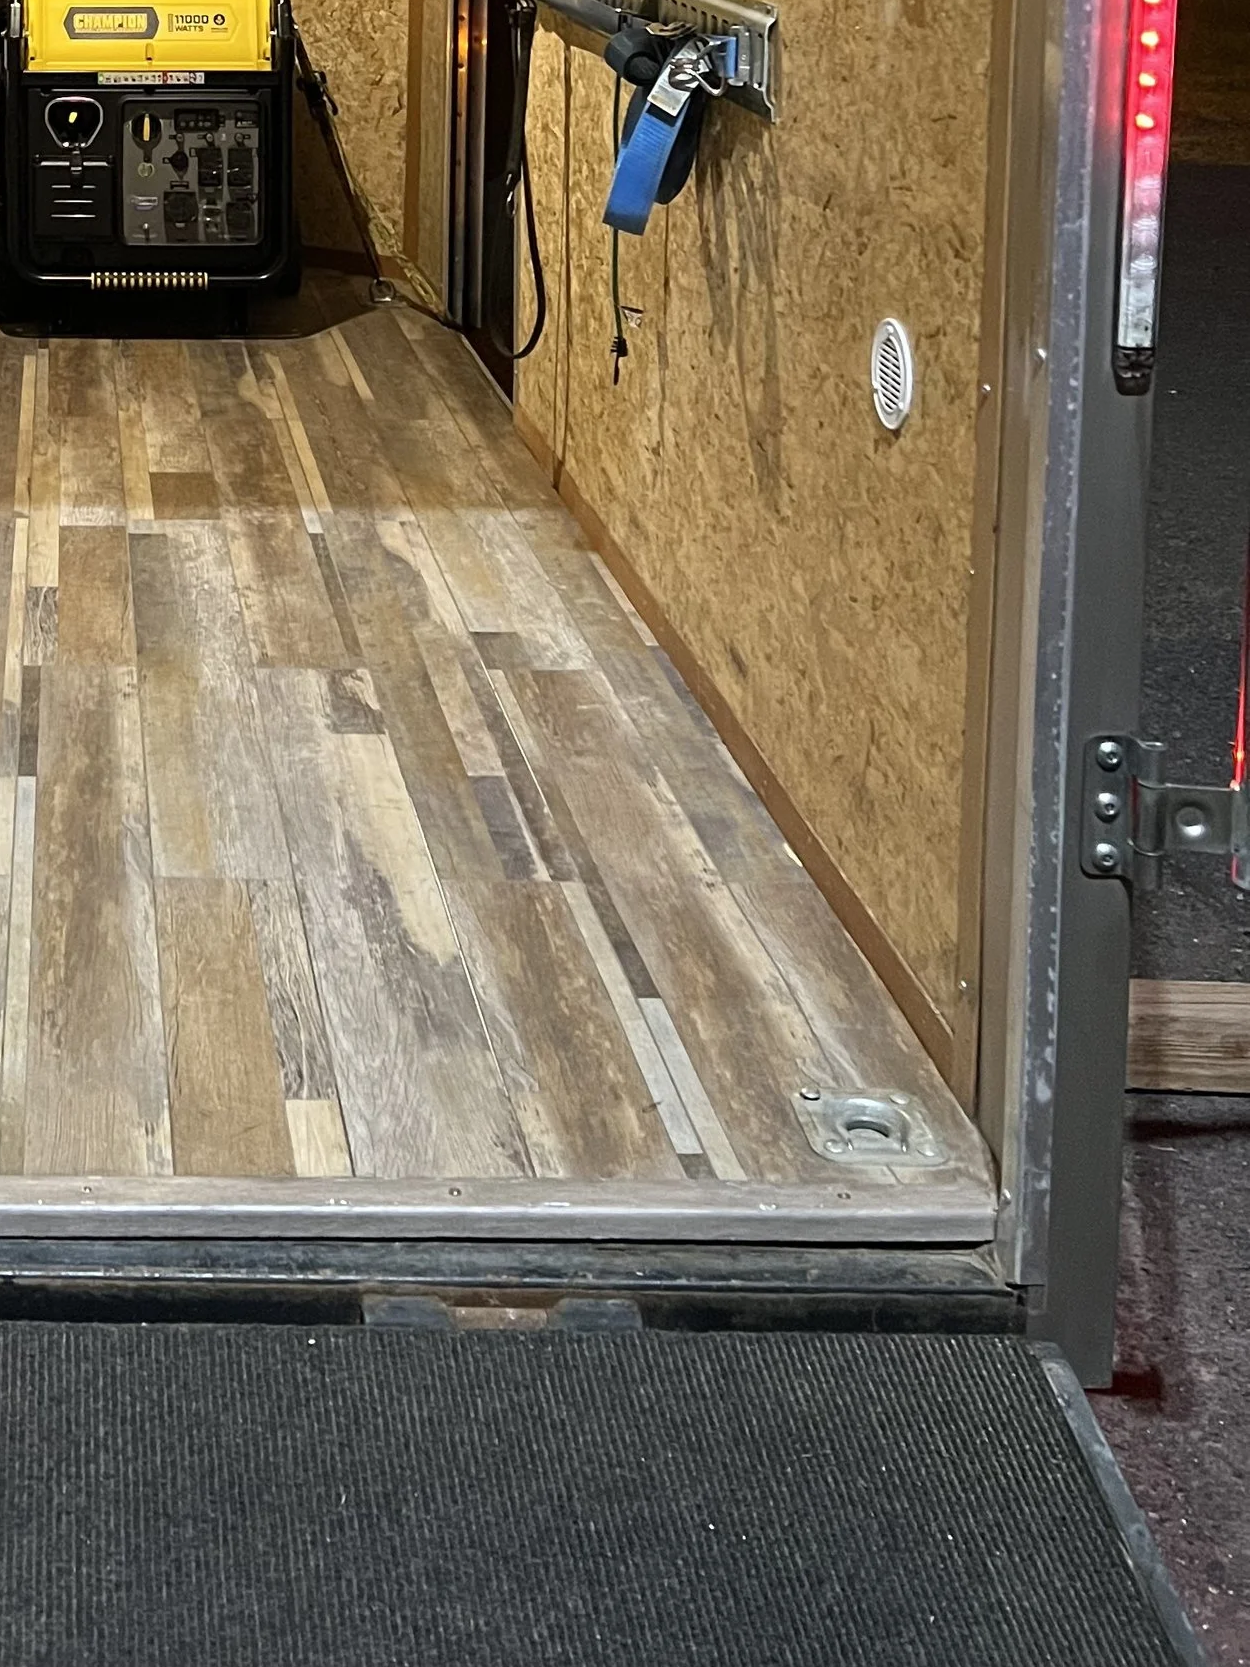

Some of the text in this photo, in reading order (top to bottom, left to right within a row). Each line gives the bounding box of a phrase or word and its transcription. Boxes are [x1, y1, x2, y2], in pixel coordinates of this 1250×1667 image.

[74, 13, 148, 32] CHAMPION
[174, 14, 209, 24] 11000
[175, 25, 204, 33] WATTS
